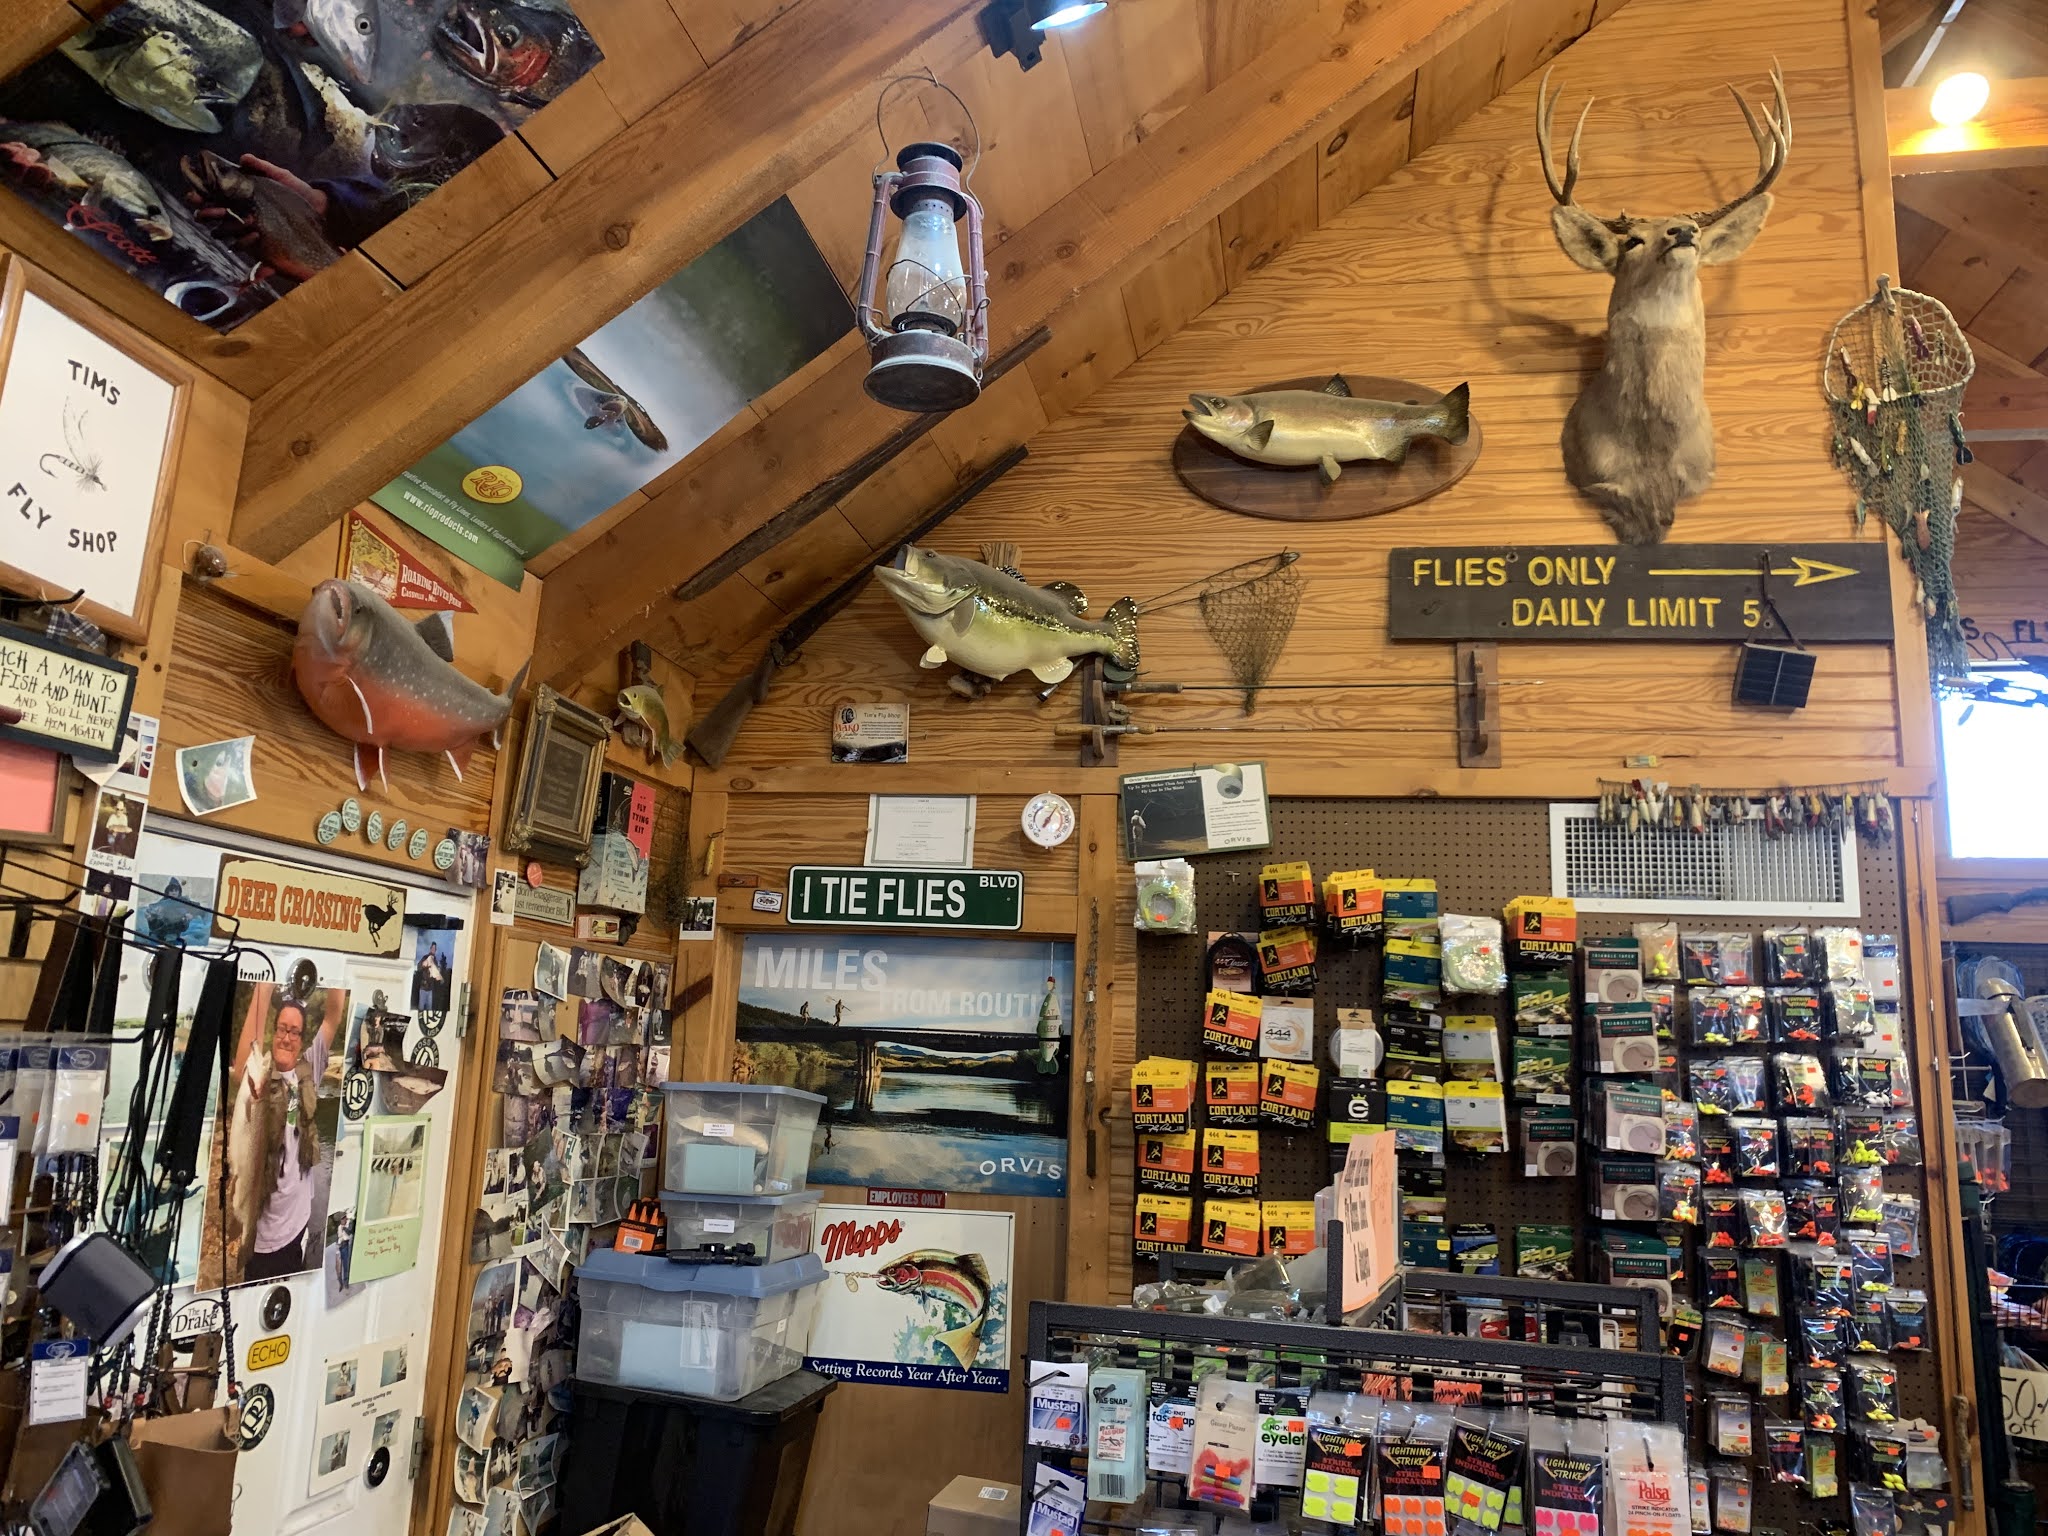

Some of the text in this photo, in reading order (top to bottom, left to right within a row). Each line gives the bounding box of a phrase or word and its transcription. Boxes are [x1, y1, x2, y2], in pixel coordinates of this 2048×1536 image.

[7, 482, 117, 554] FLY SHOP
[404, 491, 479, 543] www.rioproducts.com
[401, 564, 433, 591] ROARING
[1413, 556, 1616, 586] FLIES ONLY
[1512, 597, 1761, 628] DAILY LIMIT 5
[2013, 620, 2048, 643] FL
[0, 667, 38, 693] FISH
[42, 681, 69, 702] AND
[37, 656, 118, 693] A MAN TO
[13, 695, 37, 709] AND
[87, 713, 115, 730] NEVER
[21, 711, 105, 742] EE HIM AGAIN
[1224, 836, 1252, 846] ORVIS
[979, 876, 1018, 889] BLVD
[225, 877, 362, 933] DEER CROSSING
[803, 877, 811, 914] I
[821, 877, 867, 914] TIE
[878, 878, 966, 918] FLIES
[1265, 904, 1306, 918] CORTLAND
[1341, 913, 1383, 928] CORTLAND
[1520, 940, 1573, 953] CORTLAND
[754, 946, 888, 992] MILES
[1267, 966, 1310, 984] CORTLAND
[880, 990, 953, 1015] FROM
[1204, 1029, 1253, 1050] CORTLAND
[1265, 1028, 1291, 1037] 444
[349, 1109, 363, 1119] USA
[1135, 1113, 1184, 1124] CORTLAND
[1209, 1106, 1258, 1116] CORTLAND
[1261, 1101, 1310, 1121] CORTLAND
[979, 1158, 1062, 1180] ORVIS
[1142, 1168, 1191, 1184] CORTLAND
[1203, 1173, 1254, 1187] CORTLAND
[869, 1190, 943, 1206] EMPLOYEES ONLY
[1211, 1204, 1223, 1212] 444
[820, 1218, 903, 1264] Mepps
[175, 1310, 219, 1333] Drake
[188, 1307, 200, 1317] The
[251, 1341, 288, 1364] ECHO
[812, 1360, 1002, 1385] Setting Records Year After Year.
[245, 1385, 269, 1401] EELS
[1037, 1398, 1078, 1413] Mustad
[2009, 1417, 2041, 1436] off
[1388, 1446, 1431, 1457] LIGHTNING
[1396, 1456, 1424, 1466] STRIKE
[1311, 1462, 1361, 1477] INDICATORS
[1455, 1458, 1505, 1482] INDICATORS
[1553, 1469, 1583, 1481] STRIKE
[1385, 1476, 1437, 1486] INDICATORS
[1638, 1480, 1671, 1502] Palsa
[1036, 1503, 1075, 1528] Mustad
